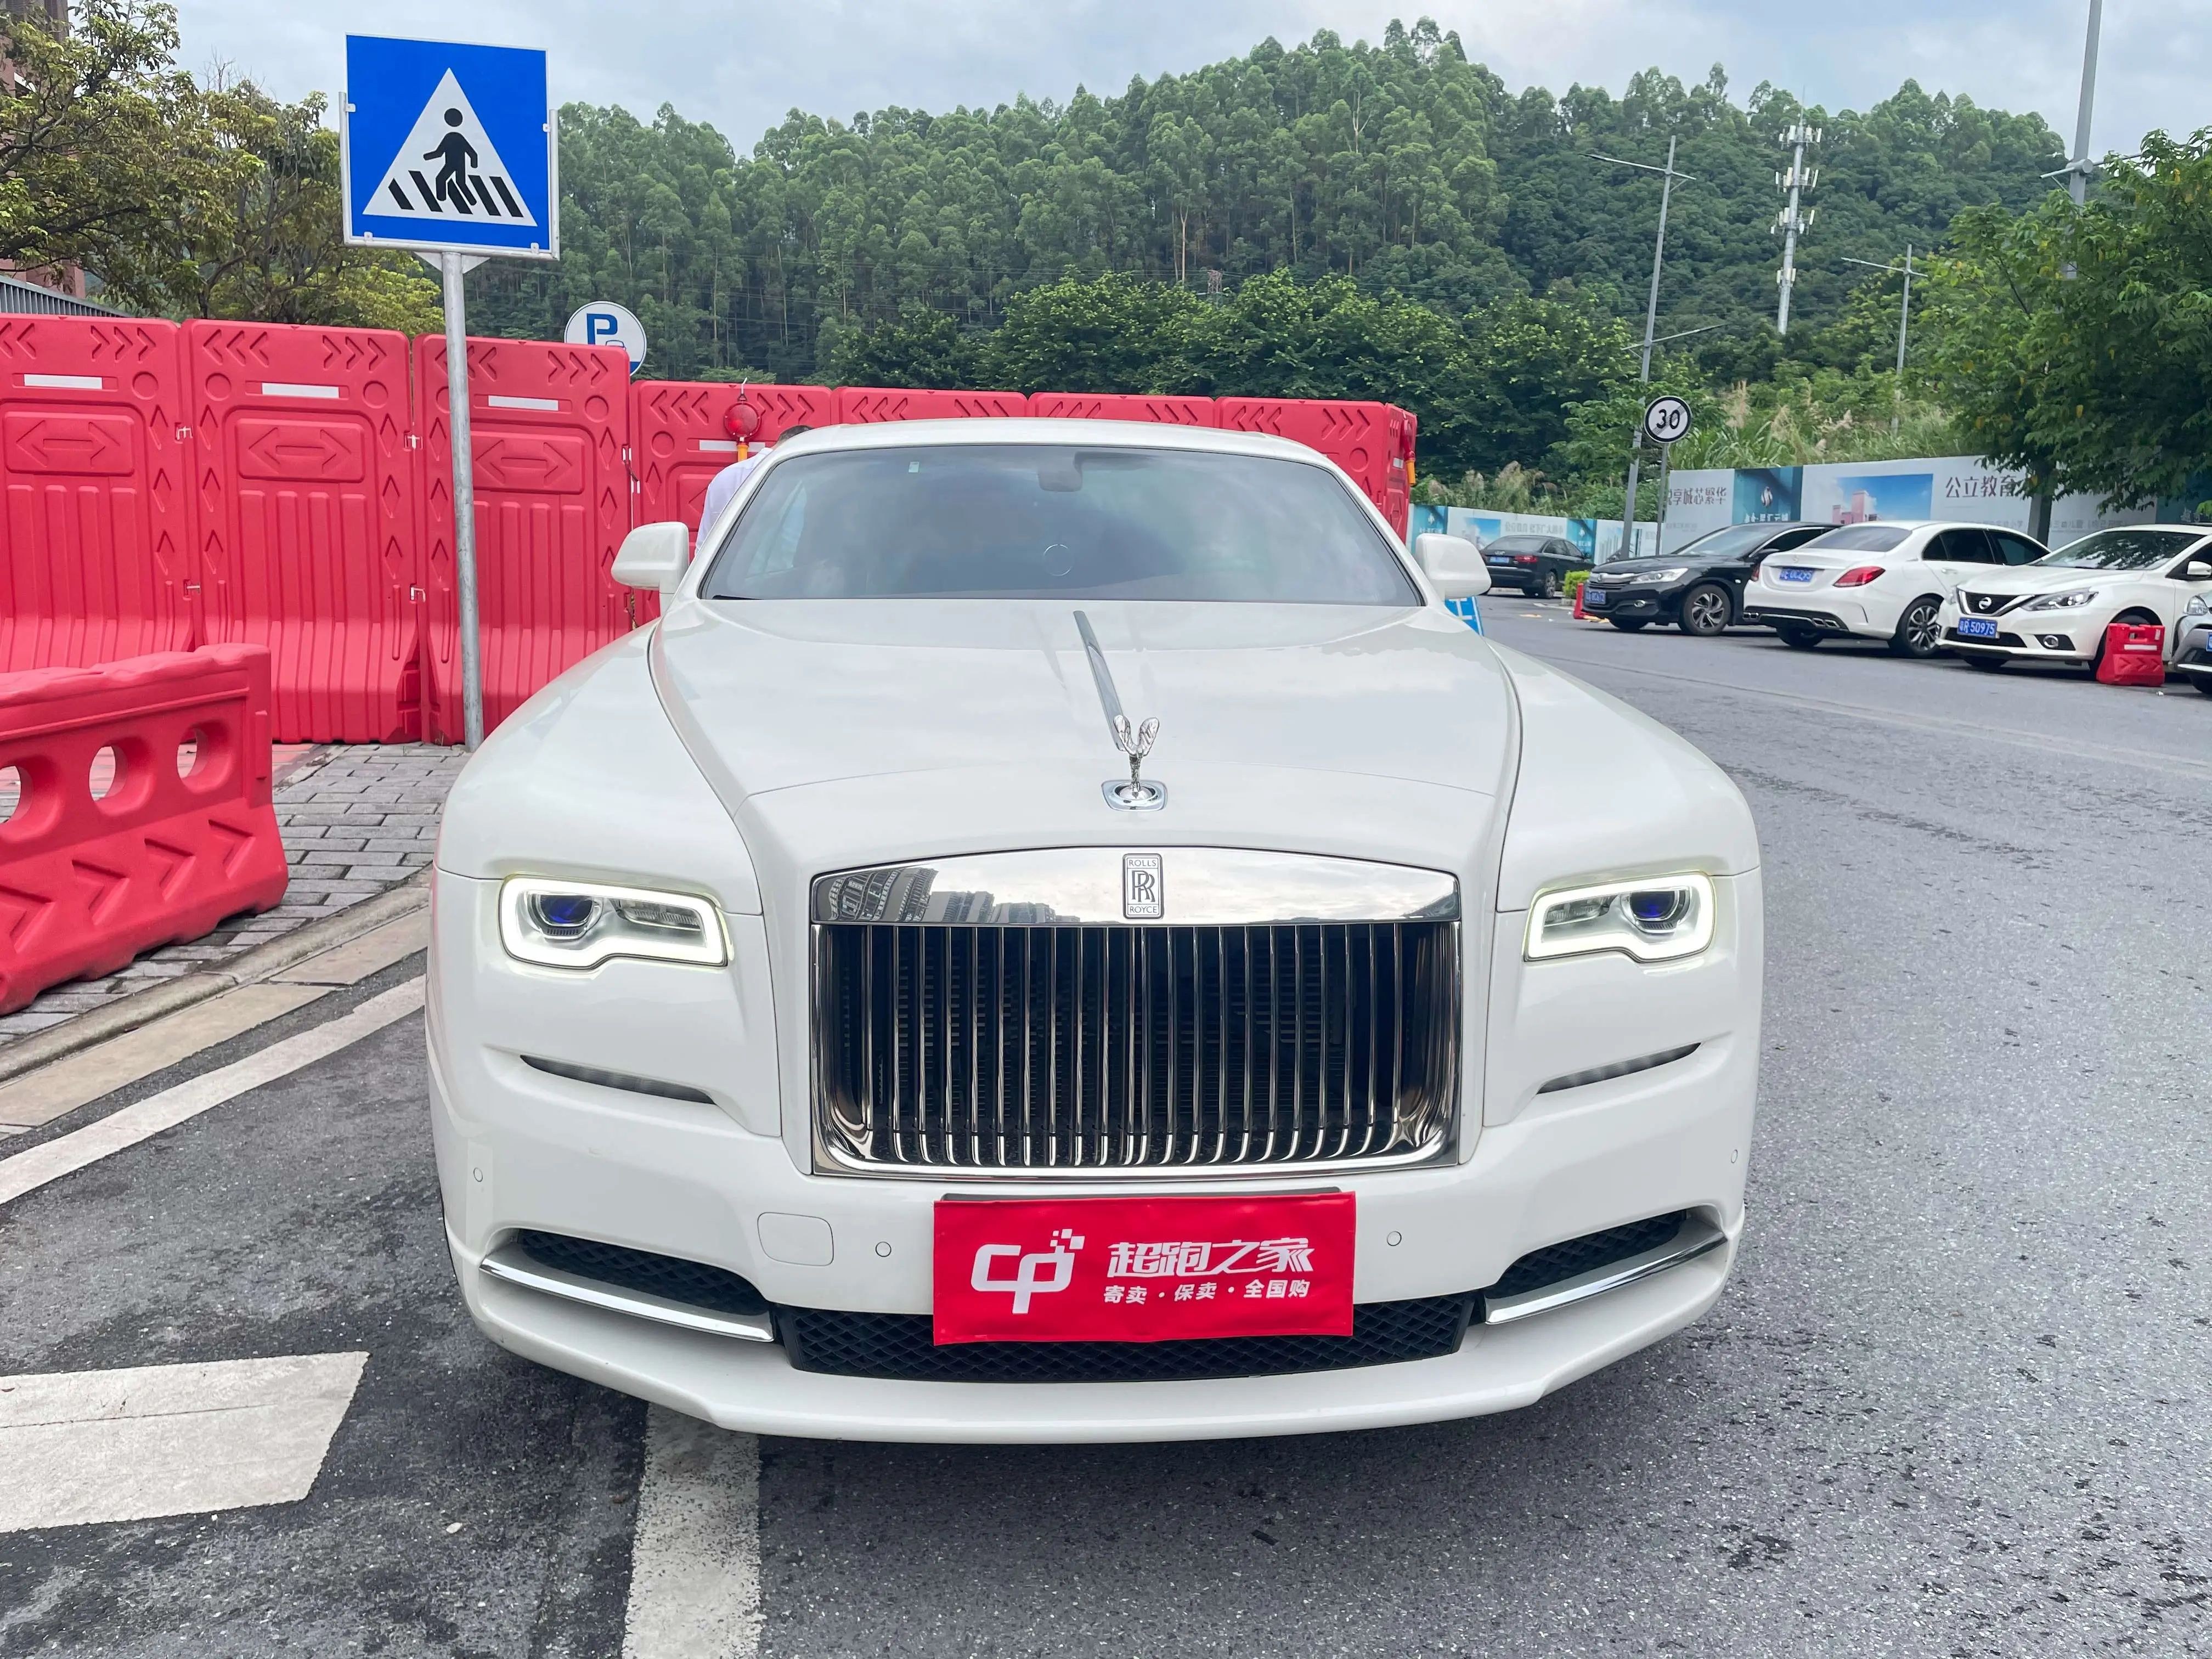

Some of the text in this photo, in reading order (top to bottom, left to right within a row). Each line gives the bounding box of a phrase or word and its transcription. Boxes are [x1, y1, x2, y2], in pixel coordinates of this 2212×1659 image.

[586, 313, 618, 345] P
[1656, 409, 1680, 429] 30
[1107, 1238, 1315, 1277] 超跑之家
